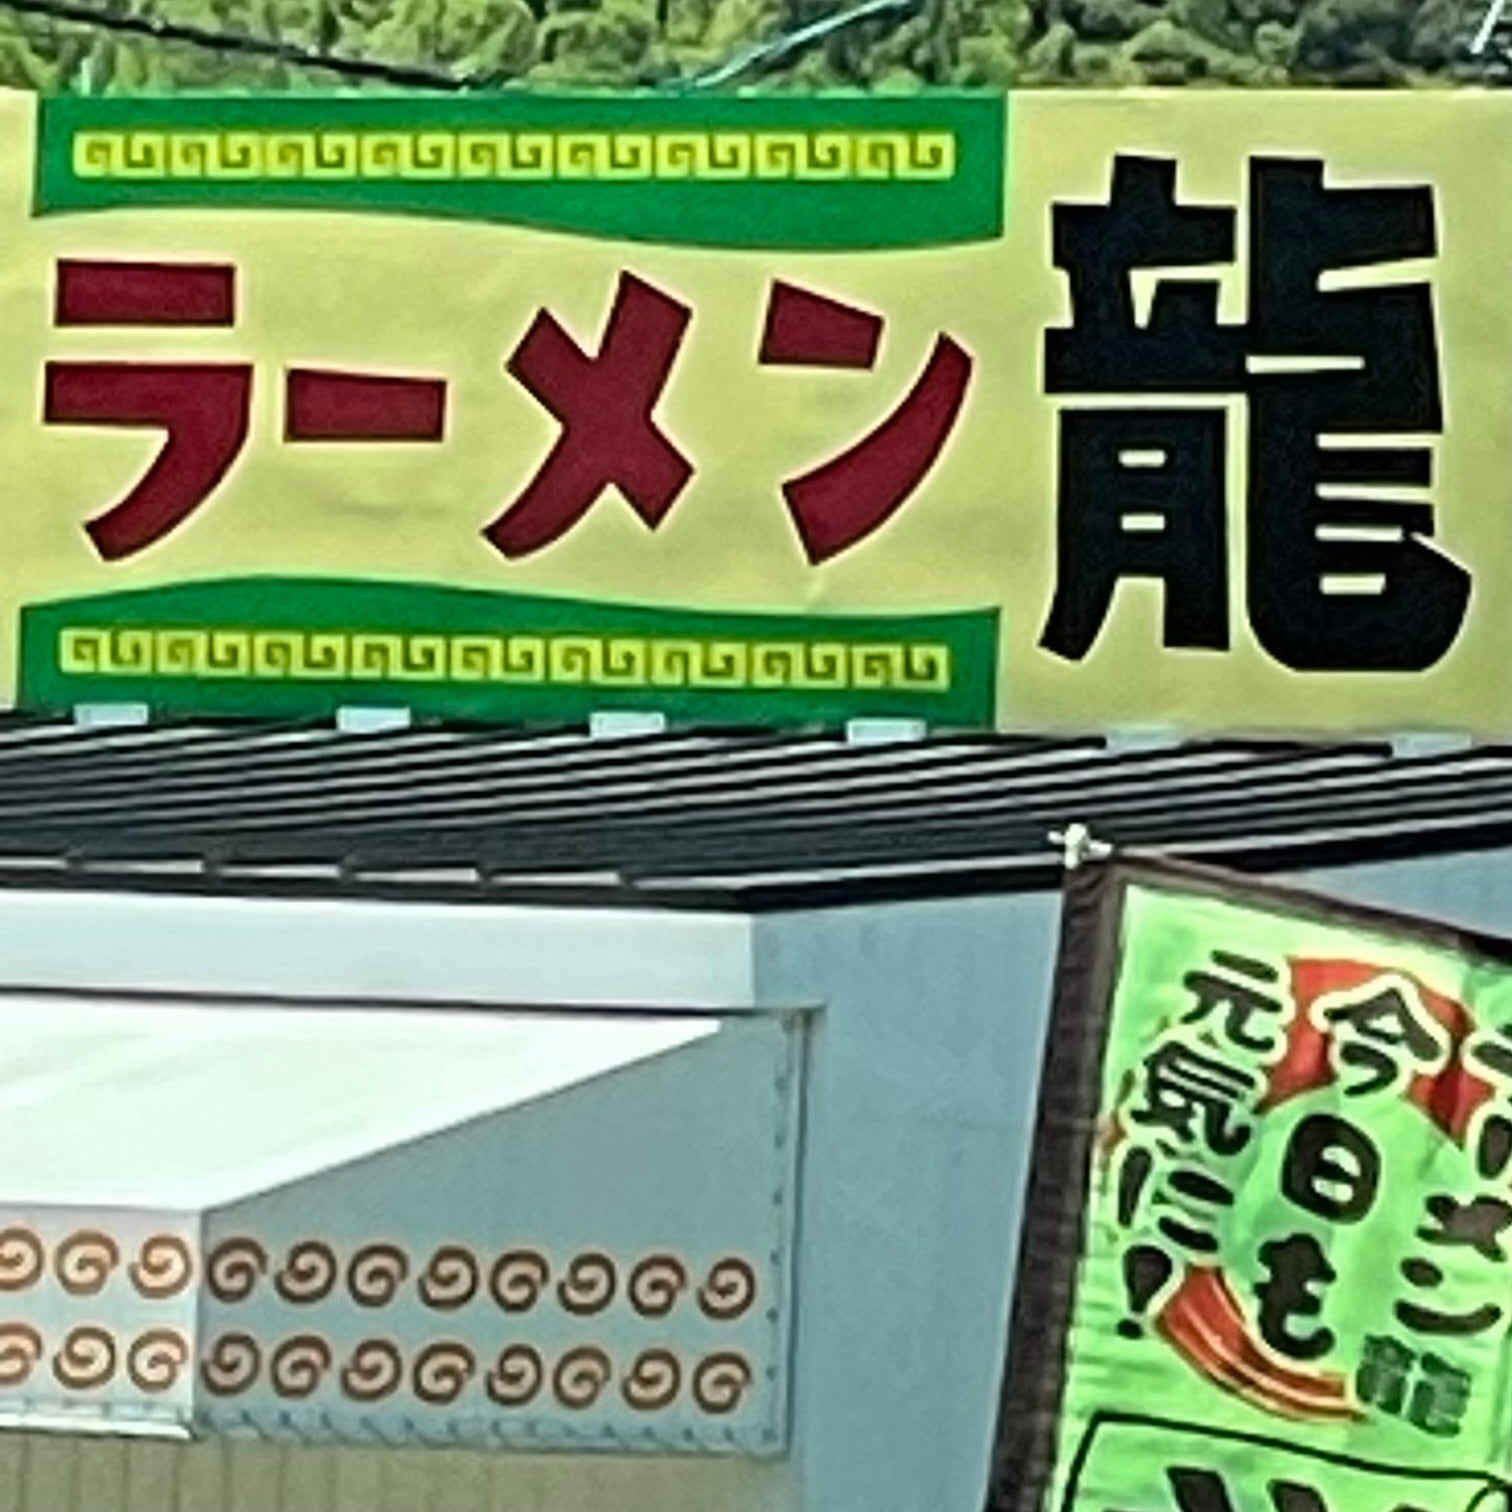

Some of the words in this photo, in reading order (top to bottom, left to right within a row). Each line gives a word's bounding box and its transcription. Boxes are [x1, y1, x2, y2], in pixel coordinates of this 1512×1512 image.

[43, 257, 973, 565] ラーメン
[1038, 152, 1472, 672] 龍
[1251, 988, 1439, 1356] 今日も
